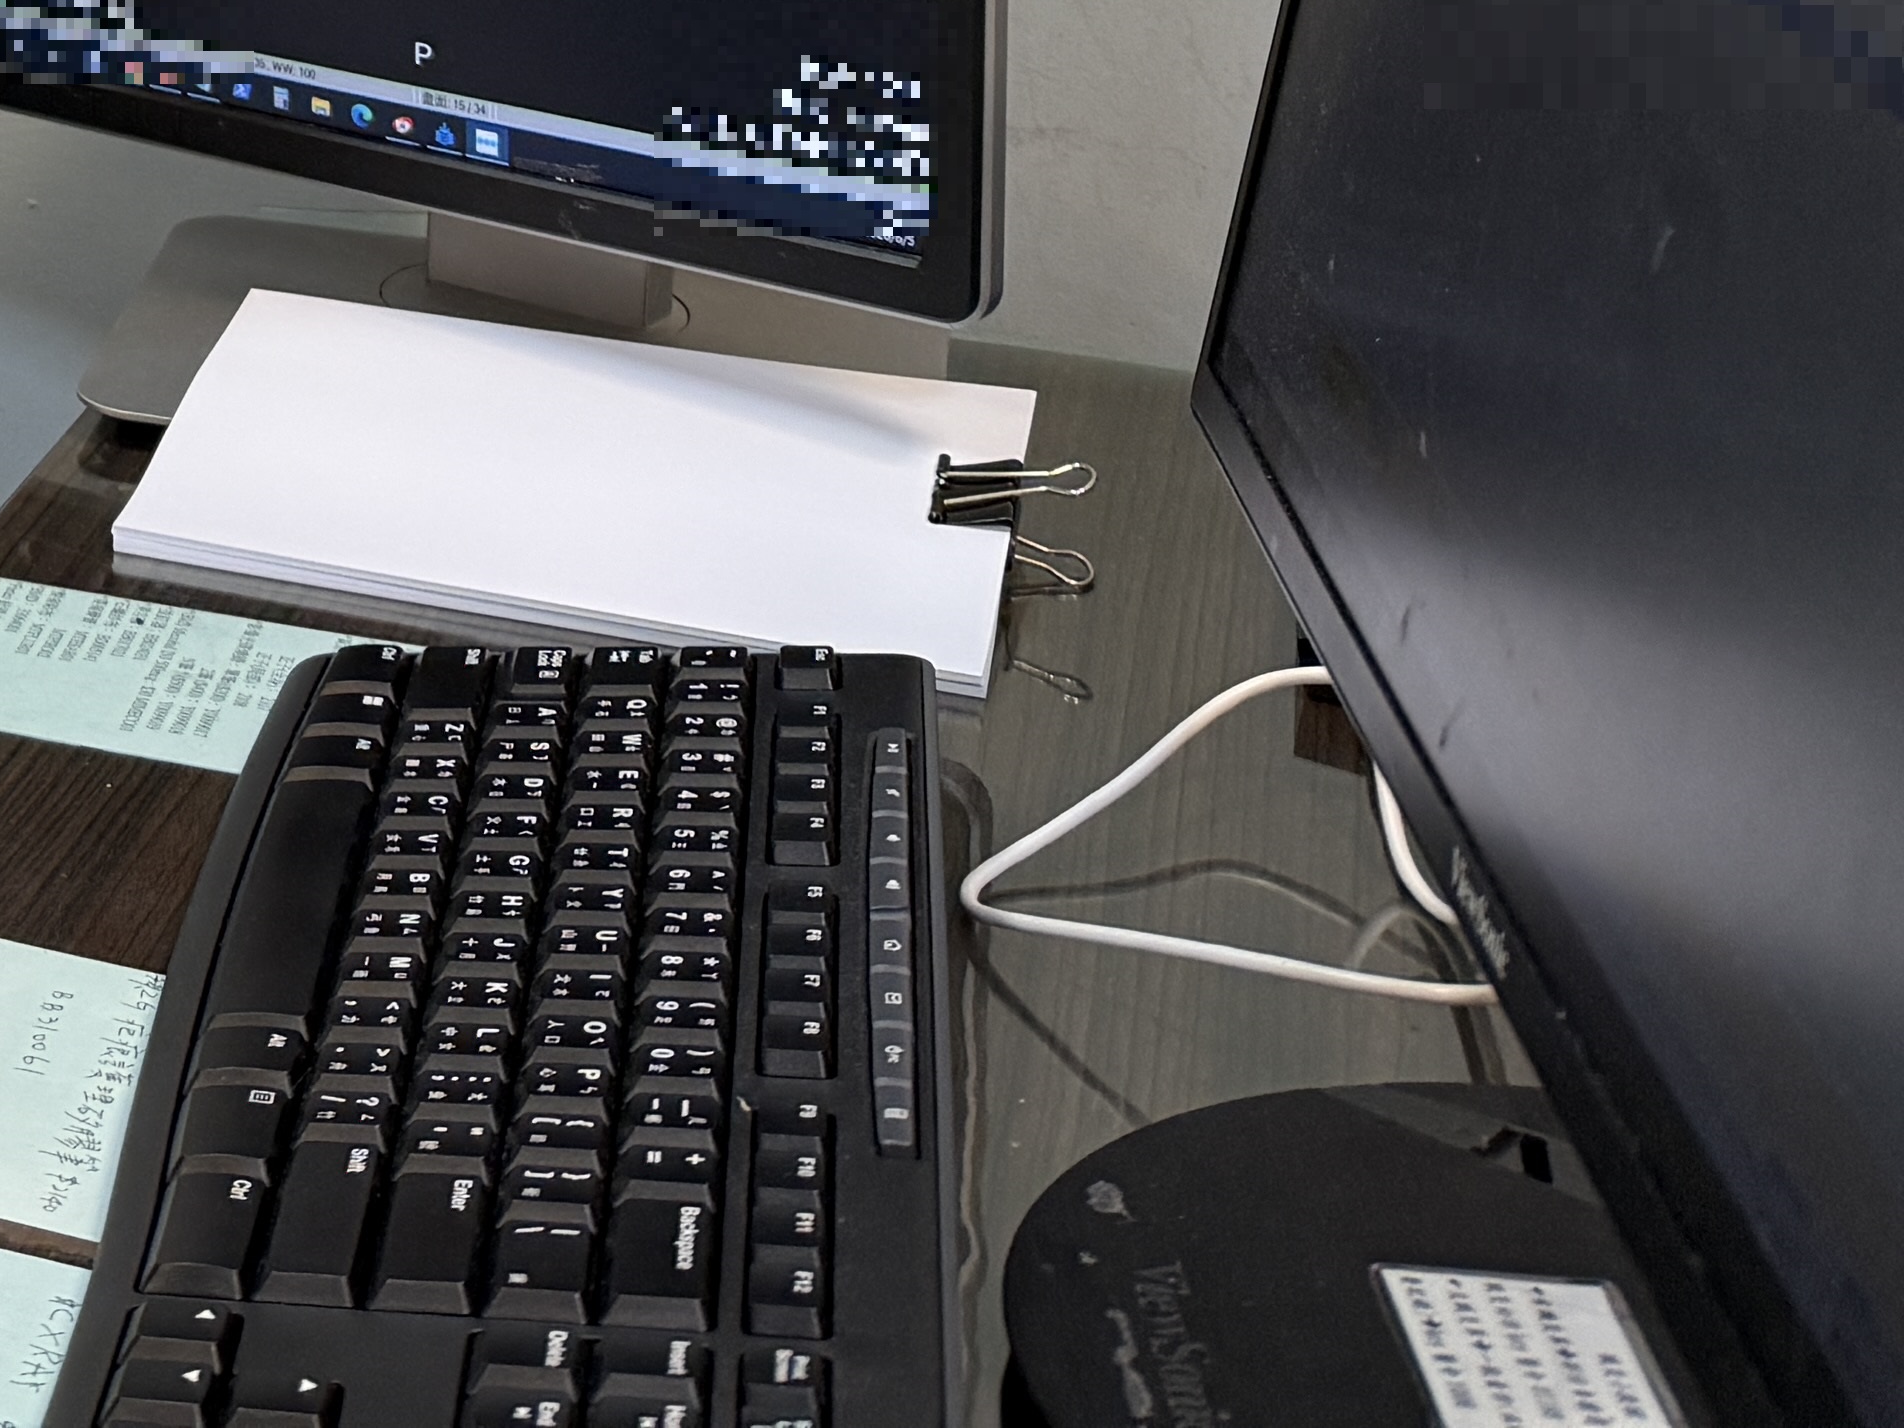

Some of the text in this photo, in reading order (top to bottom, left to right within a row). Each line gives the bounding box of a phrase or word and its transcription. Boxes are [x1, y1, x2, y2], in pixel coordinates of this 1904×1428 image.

[414, 41, 433, 65] P
[298, 66, 317, 80] 100
[688, 682, 708, 690] 1
[626, 699, 648, 710] Q
[537, 707, 557, 717] A
[685, 716, 704, 725] 2
[444, 723, 465, 733] Z
[621, 733, 642, 746] W
[530, 742, 550, 751] S
[681, 752, 703, 761] 3
[436, 758, 456, 768] X
[618, 770, 639, 779] E
[523, 778, 544, 788] D
[677, 789, 699, 799] 4
[427, 795, 449, 805] C
[612, 807, 634, 818] R
[516, 815, 537, 825] F
[809, 817, 825, 828] F4
[418, 833, 439, 844] V
[674, 828, 696, 838] 5
[607, 847, 629, 858] T
[508, 855, 530, 866] G
[409, 873, 431, 883] B
[668, 869, 691, 878] 6
[601, 888, 624, 898] Y
[501, 895, 524, 906] H
[398, 913, 421, 924] N
[665, 911, 688, 921] 7
[595, 930, 618, 941] U
[493, 937, 516, 948] J
[389, 956, 412, 968] M
[661, 955, 684, 965] 8
[804, 974, 821, 987] F7
[485, 982, 509, 993] K
[655, 1000, 680, 1011] 9
[583, 1020, 607, 1034] O
[476, 1028, 500, 1038] L
[577, 1068, 601, 1080] P
[346, 1148, 369, 1173] Shift
[797, 1157, 816, 1177] F10
[229, 1179, 252, 1200] Ctrl
[451, 1179, 474, 1211] Enter
[674, 1206, 701, 1270] Backspace
[793, 1270, 814, 1293] F12
